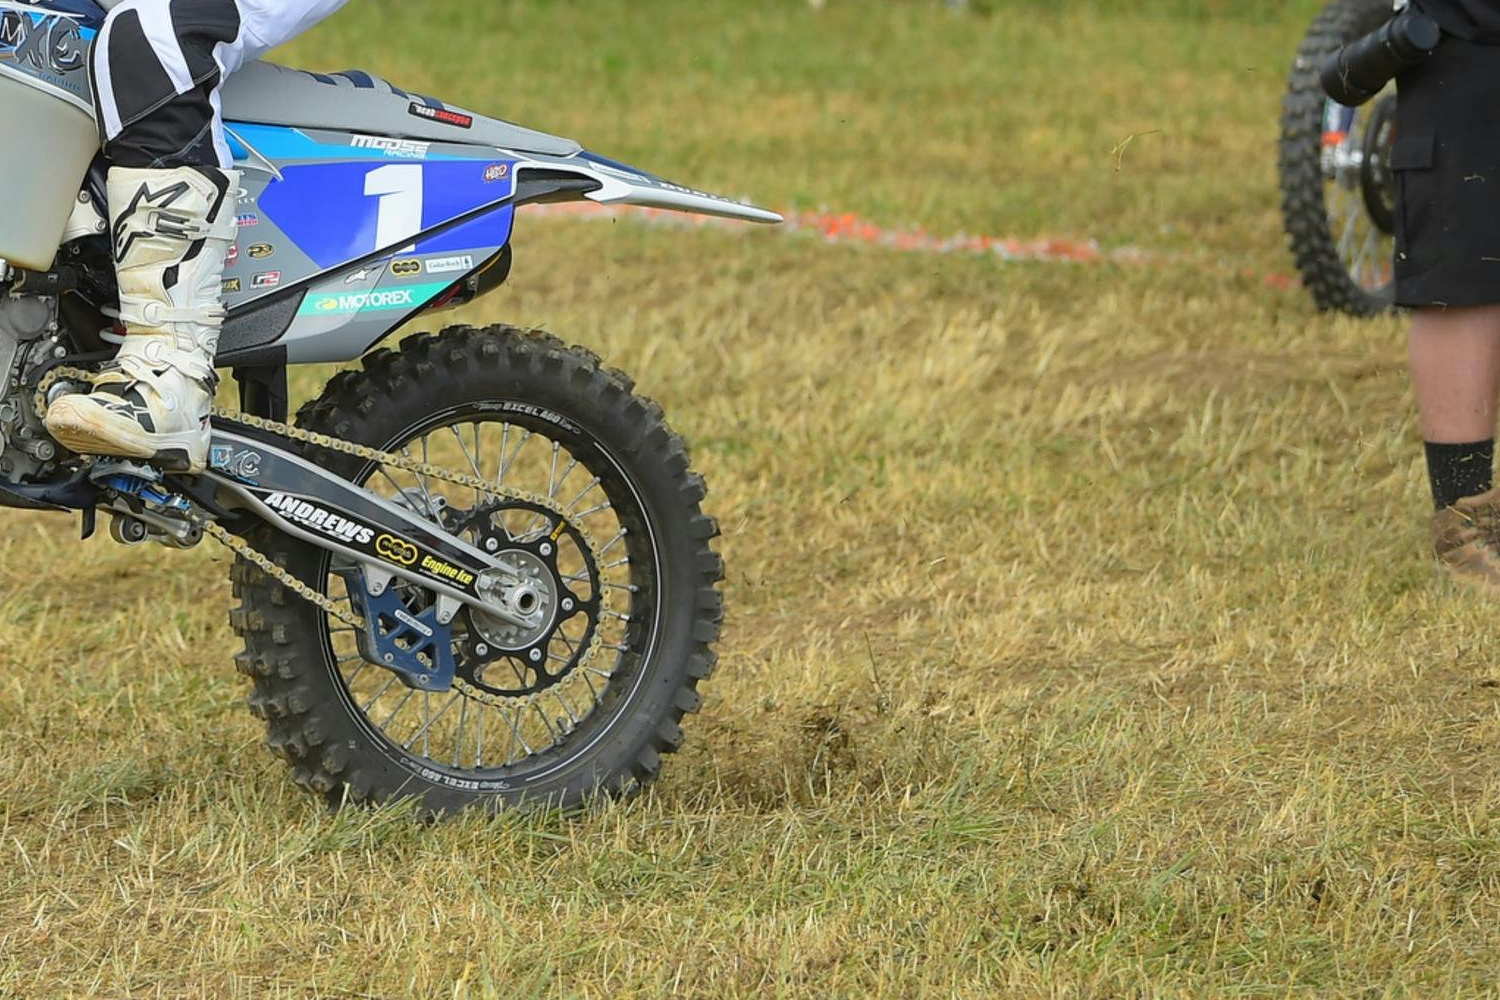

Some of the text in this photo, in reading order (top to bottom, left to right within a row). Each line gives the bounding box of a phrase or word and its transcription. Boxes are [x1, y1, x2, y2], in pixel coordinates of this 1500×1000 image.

[351, 135, 431, 154] MOOSE
[364, 164, 423, 252] 1
[339, 290, 413, 311] MOTOREX
[264, 491, 376, 545] ANDREWS
[421, 555, 458, 579] Engine
[456, 568, 474, 584] Ice
